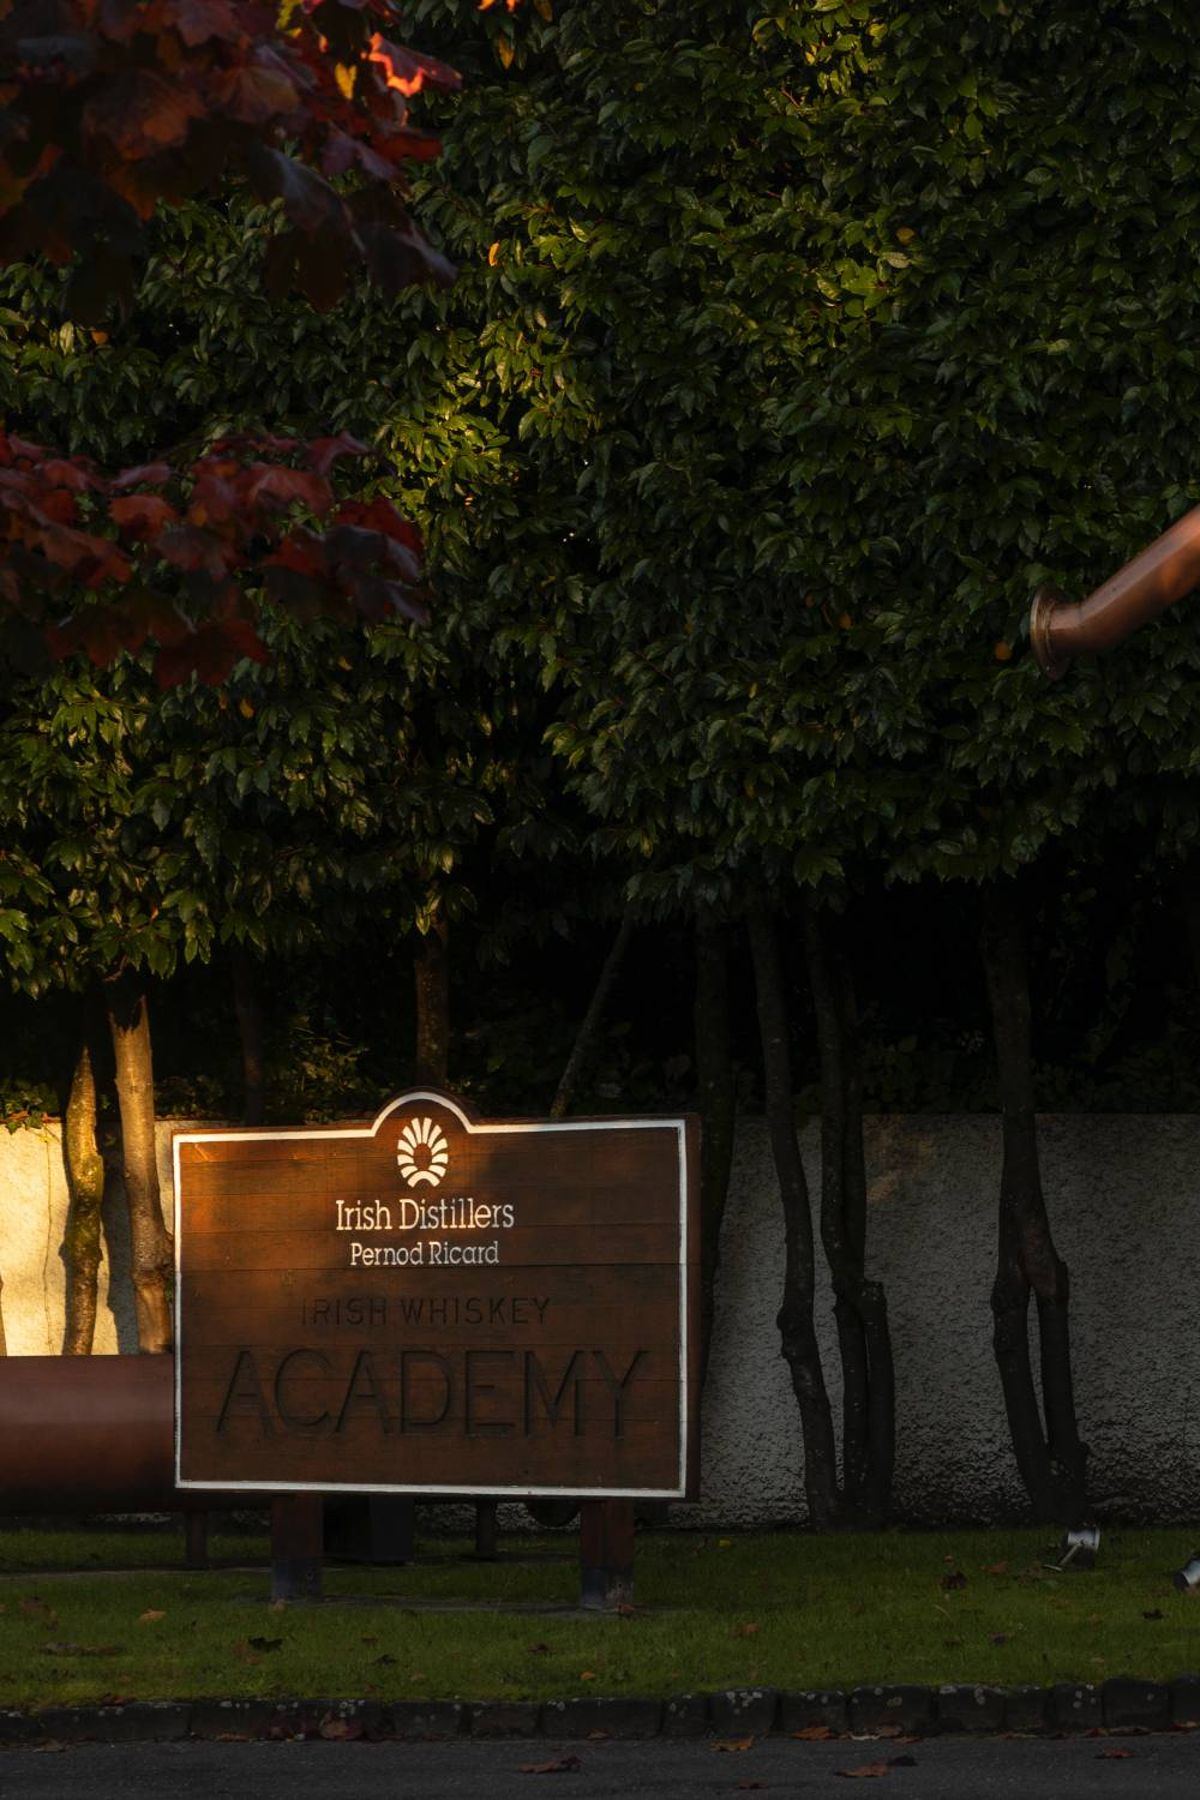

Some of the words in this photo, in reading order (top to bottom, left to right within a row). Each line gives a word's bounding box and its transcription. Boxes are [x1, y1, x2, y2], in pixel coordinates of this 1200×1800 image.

[335, 1199, 391, 1231] Irish
[399, 1198, 515, 1230] Distillers
[350, 1242, 424, 1266] Pernod
[429, 1241, 499, 1265] Ricard
[301, 1298, 388, 1325] IRISH
[401, 1297, 551, 1324] WHISKEY
[216, 1348, 648, 1440] ACADEMY
